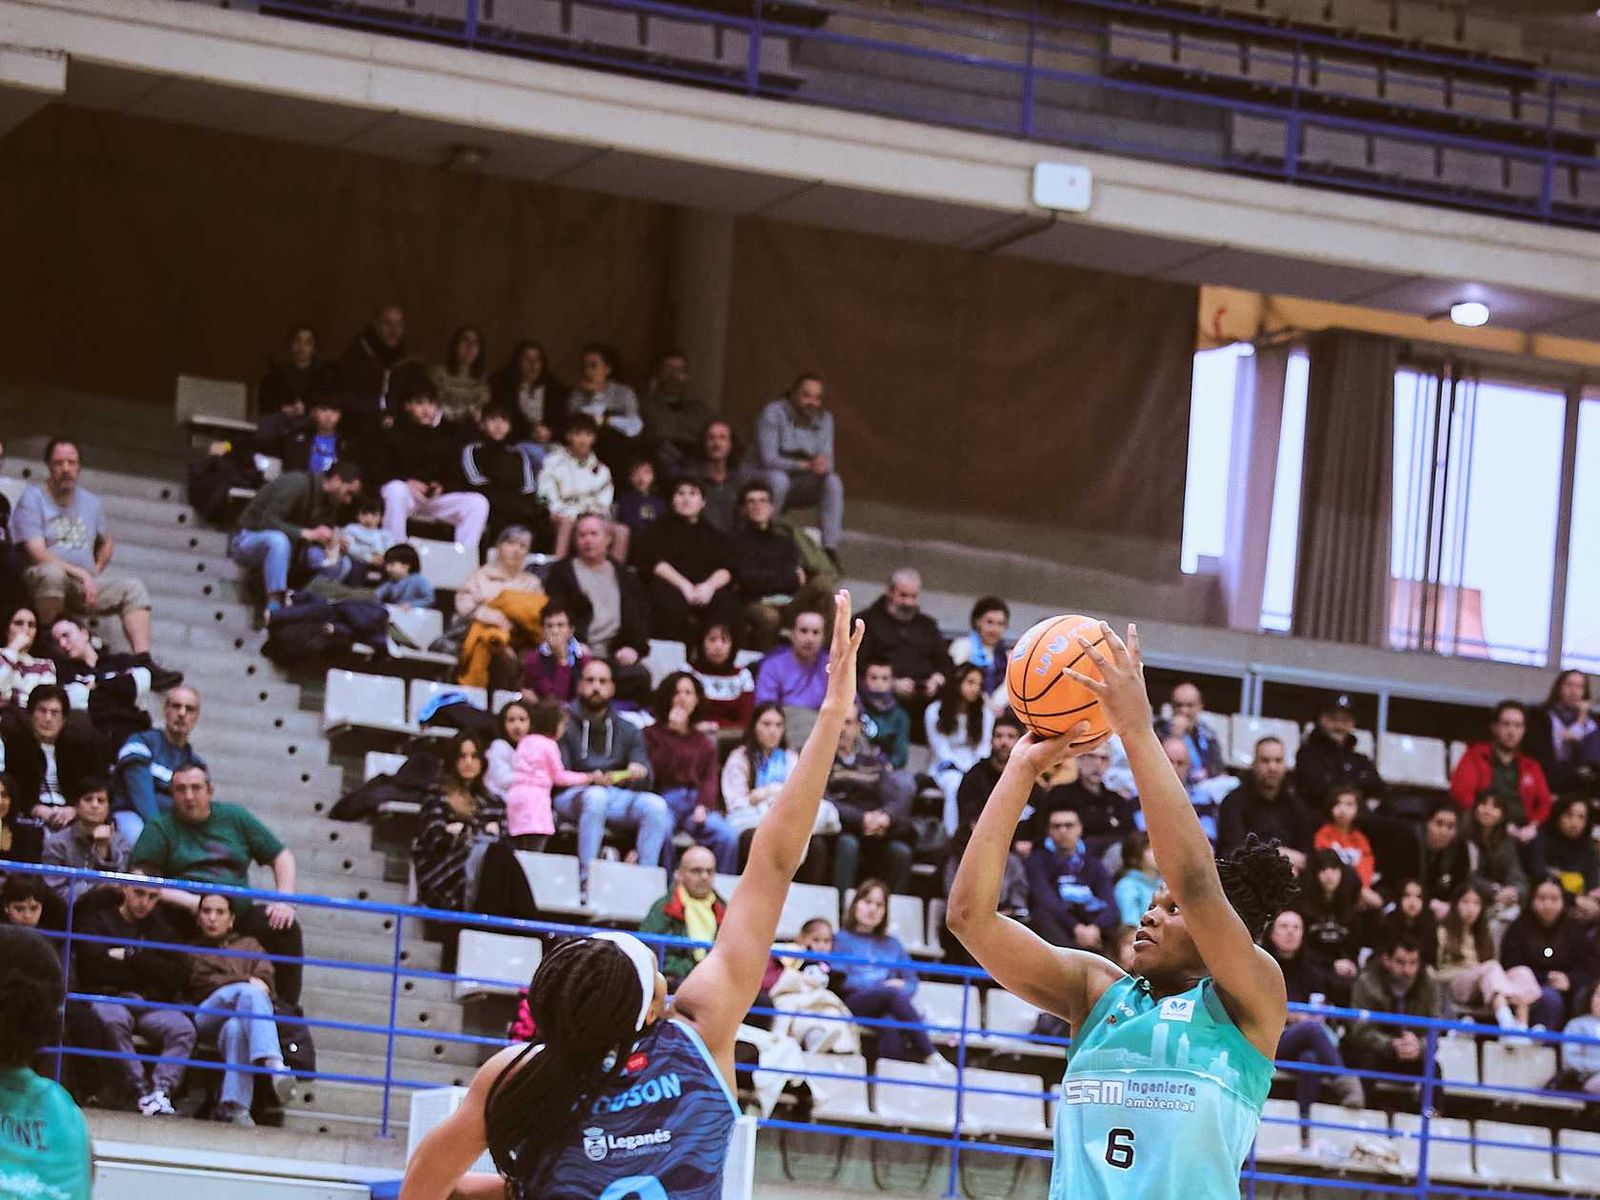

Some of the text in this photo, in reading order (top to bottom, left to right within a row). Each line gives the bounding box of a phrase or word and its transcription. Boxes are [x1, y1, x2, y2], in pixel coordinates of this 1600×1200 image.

[1125, 1097, 1196, 1113] ambiental
[607, 1129, 672, 1151] Leganés
[1105, 1127, 1136, 1170] 6
